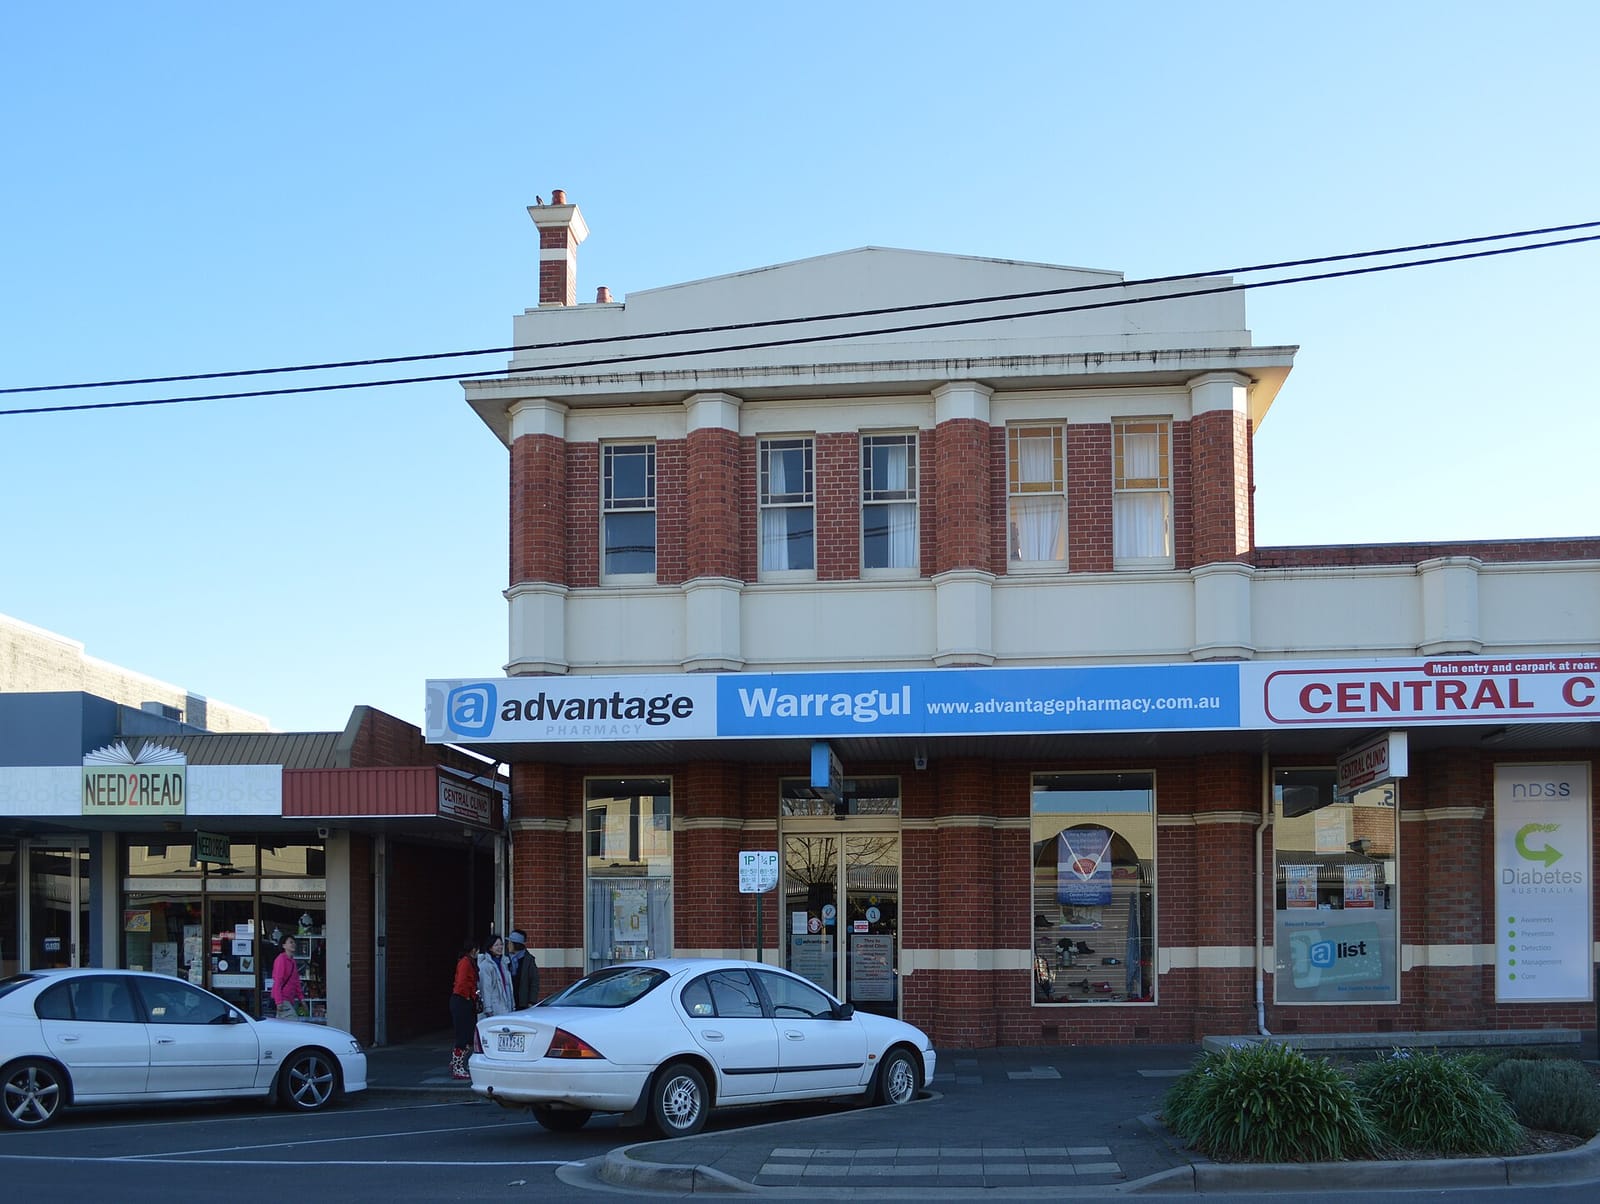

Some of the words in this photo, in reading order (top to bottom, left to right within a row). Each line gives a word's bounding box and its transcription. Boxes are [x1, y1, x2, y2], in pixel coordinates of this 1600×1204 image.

[1432, 663, 1458, 674] Main
[1461, 664, 1489, 675] entry
[1492, 662, 1512, 673] and
[1515, 661, 1556, 674] carpark
[1558, 661, 1571, 671] at
[738, 685, 911, 723] Warragul
[926, 694, 1220, 715] www.advantagepharmacy.com.au
[1299, 678, 1534, 714] CENTRAL
[501, 691, 694, 726] advantage
[546, 723, 642, 736] PHARMACY
[85, 773, 182, 806] NEED2READ
[443, 787, 469, 808] CENTRAL
[744, 855, 755, 865] 1P
[1502, 868, 1583, 885] Diabetes
[1511, 887, 1574, 895] AUSTRALIA
[1338, 942, 1366, 959] list
